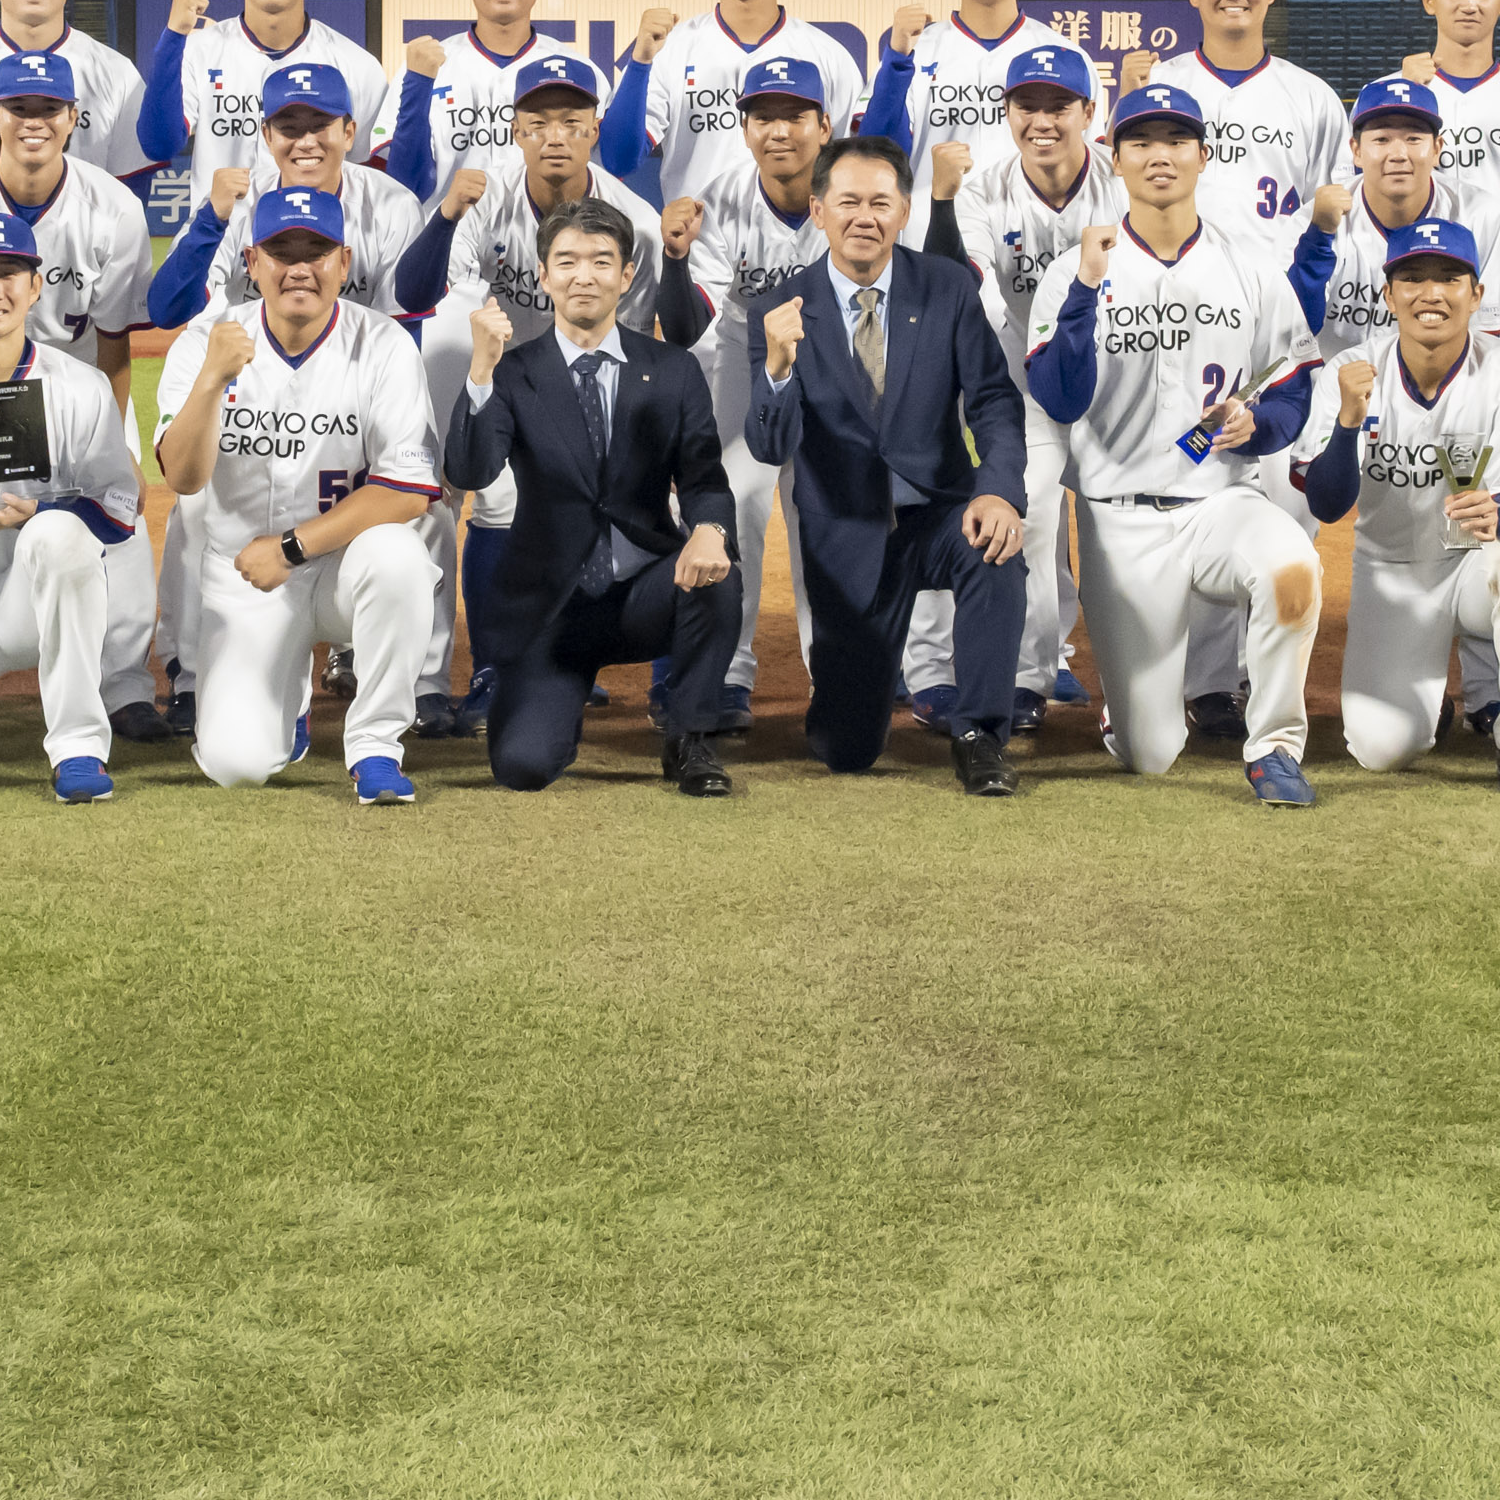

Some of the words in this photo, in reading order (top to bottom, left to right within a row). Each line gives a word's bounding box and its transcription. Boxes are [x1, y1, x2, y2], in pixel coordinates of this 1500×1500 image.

[1050, 10, 1178, 51] 洋服の
[930, 84, 1005, 104] TOKYO
[1252, 125, 1294, 149] GAS
[46, 266, 84, 290] GAS
[1106, 303, 1187, 328] TOKYO
[1194, 304, 1241, 329] GAS
[1104, 330, 1191, 354] GROUP
[221, 407, 305, 435] TOKYO
[311, 413, 358, 436] GAS
[220, 434, 306, 460] GROUP
